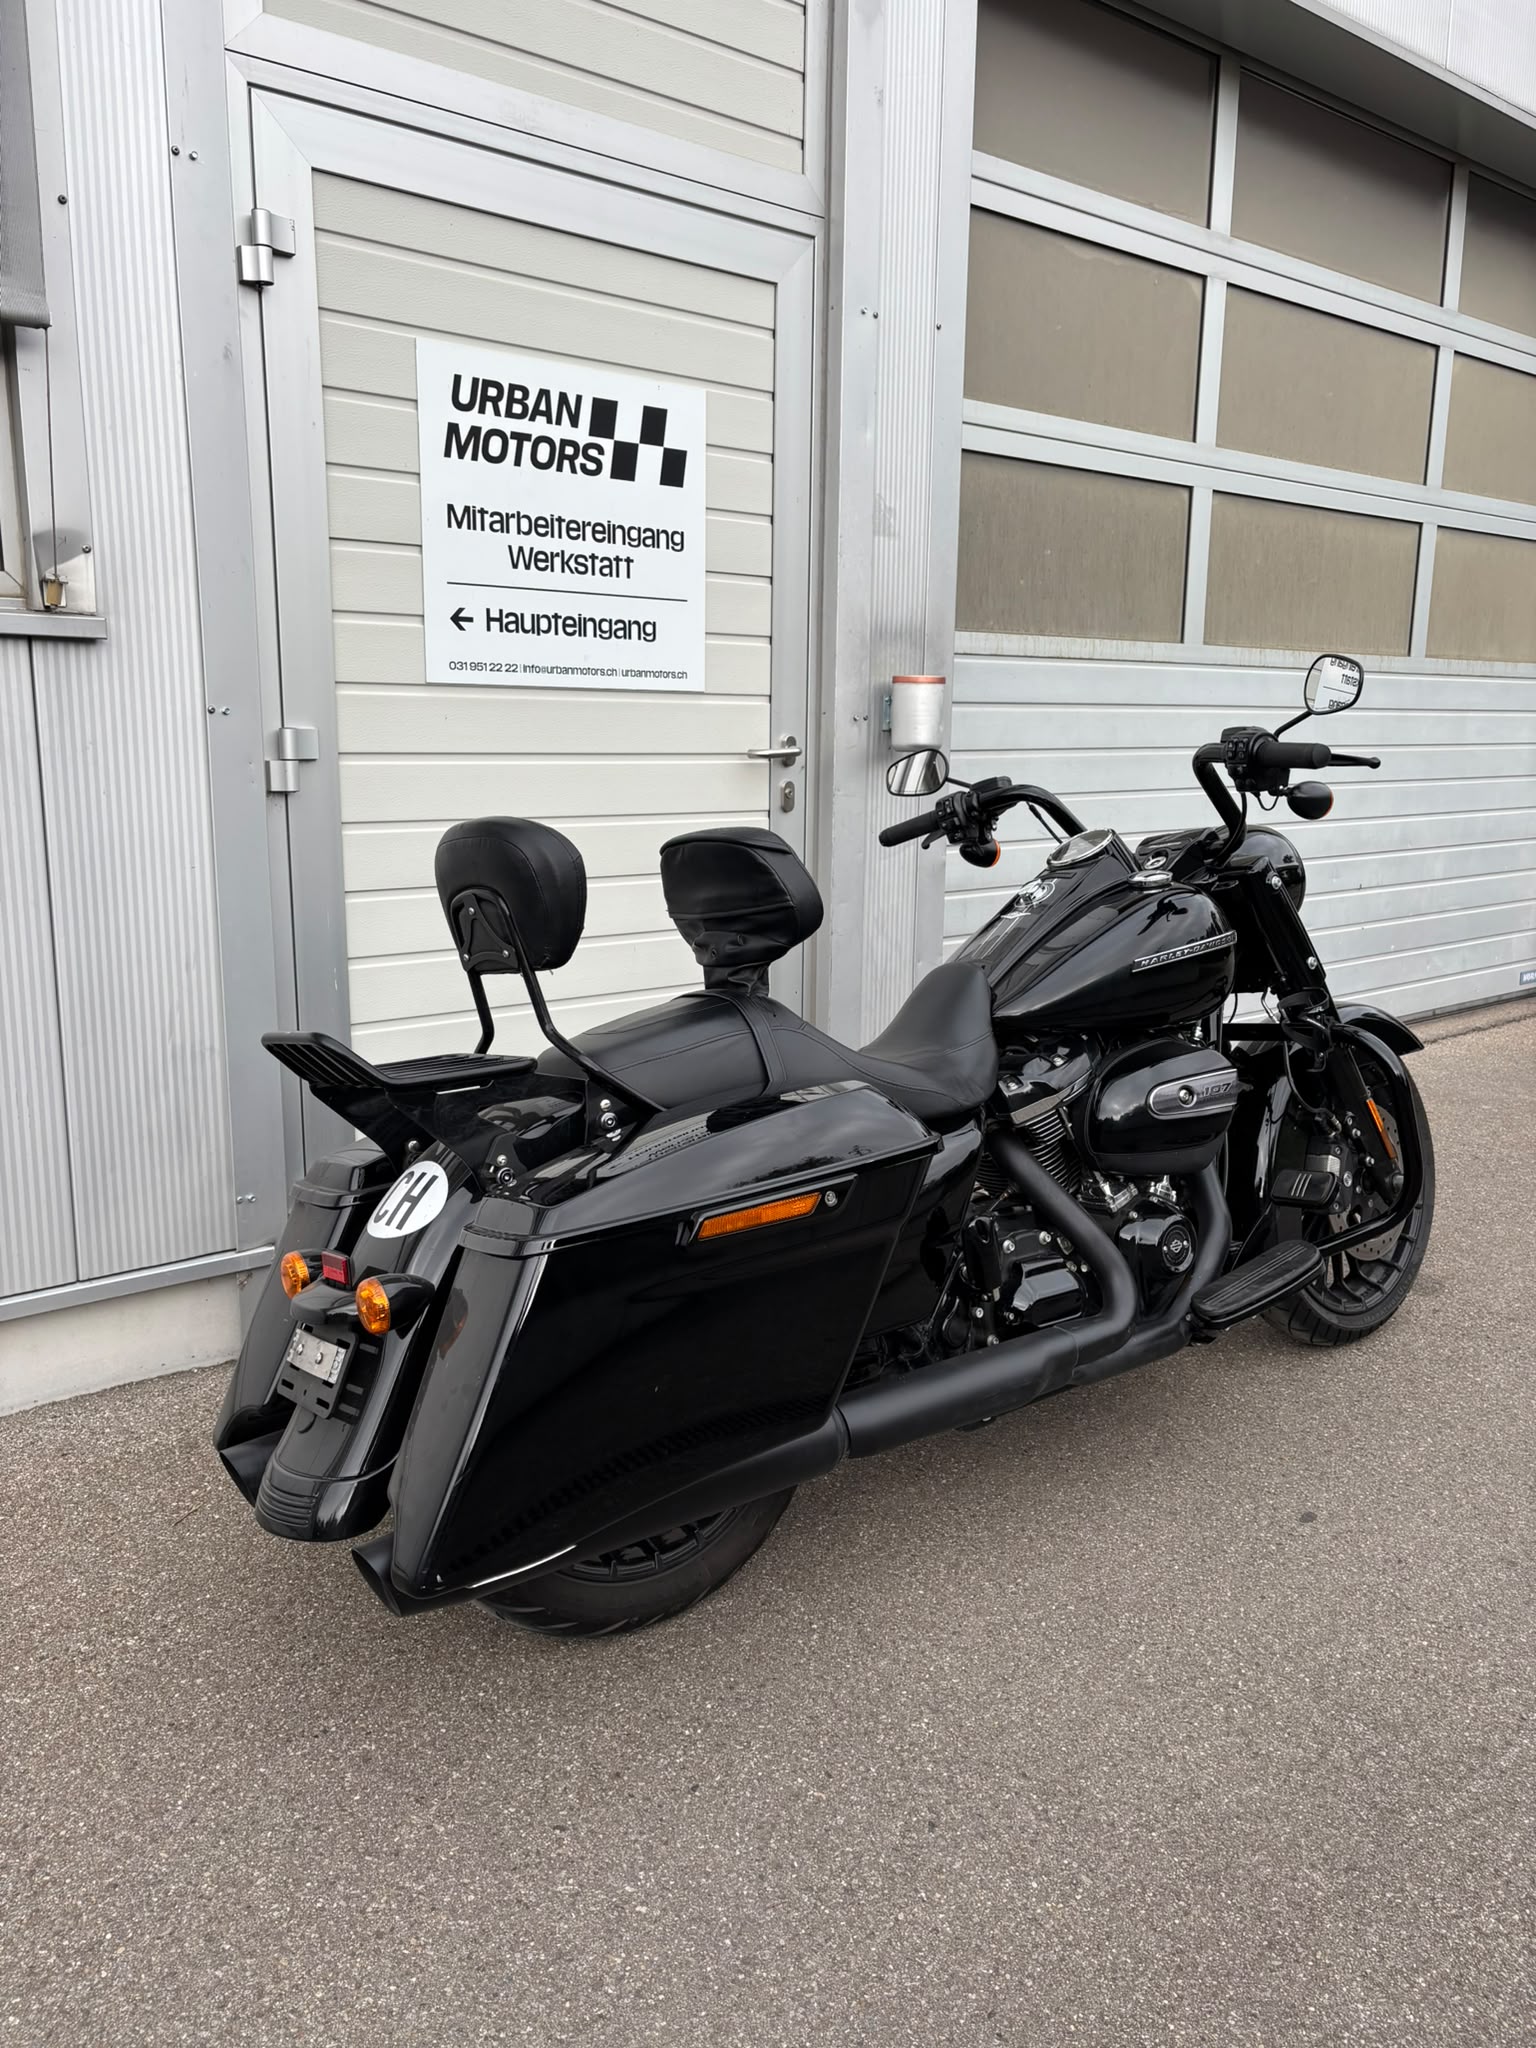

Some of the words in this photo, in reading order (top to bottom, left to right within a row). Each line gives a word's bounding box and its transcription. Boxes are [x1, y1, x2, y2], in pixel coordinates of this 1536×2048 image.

[451, 373, 583, 429] URBAN
[443, 421, 605, 477] MOTORS
[446, 503, 685, 553] Mitarbeitereingang
[507, 544, 634, 580] Werkstatt
[485, 607, 657, 643] Haupteingang
[504, 663, 519, 673] 22
[621, 669, 688, 679] urbanmotors.ch
[373, 1170, 439, 1231] CH
